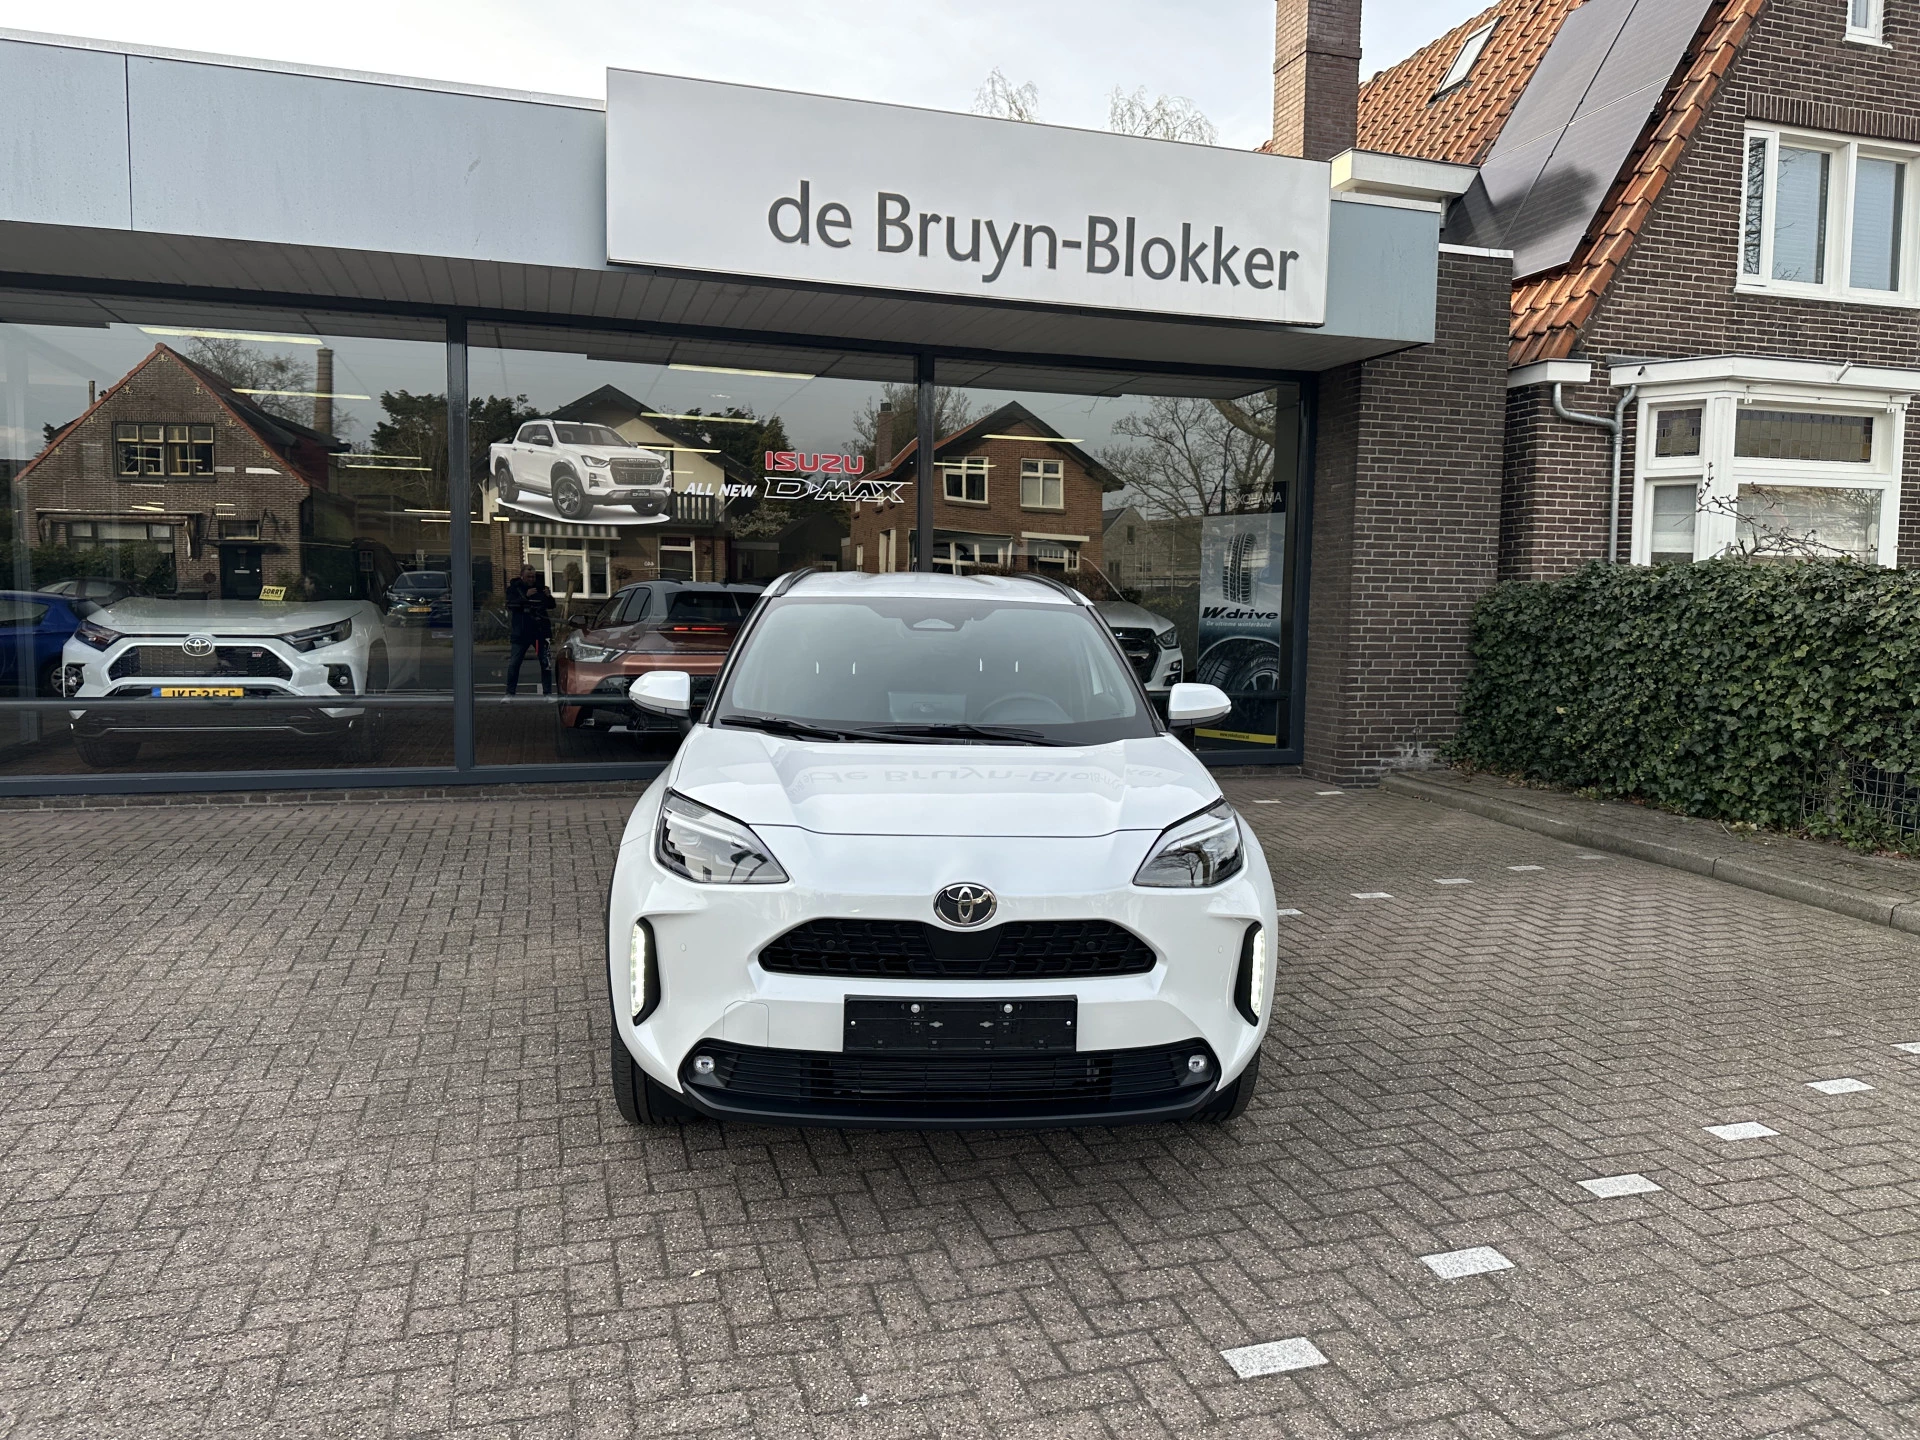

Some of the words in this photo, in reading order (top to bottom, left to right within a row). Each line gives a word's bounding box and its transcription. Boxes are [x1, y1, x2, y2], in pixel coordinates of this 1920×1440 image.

[768, 180, 853, 249] de
[877, 191, 1300, 291] Bruyn-Blokker
[764, 451, 865, 475] ISUZU
[684, 482, 715, 497] ALL
[718, 483, 757, 498] NEW
[263, 587, 284, 595] SORRY
[1202, 606, 1279, 620] W.drive
